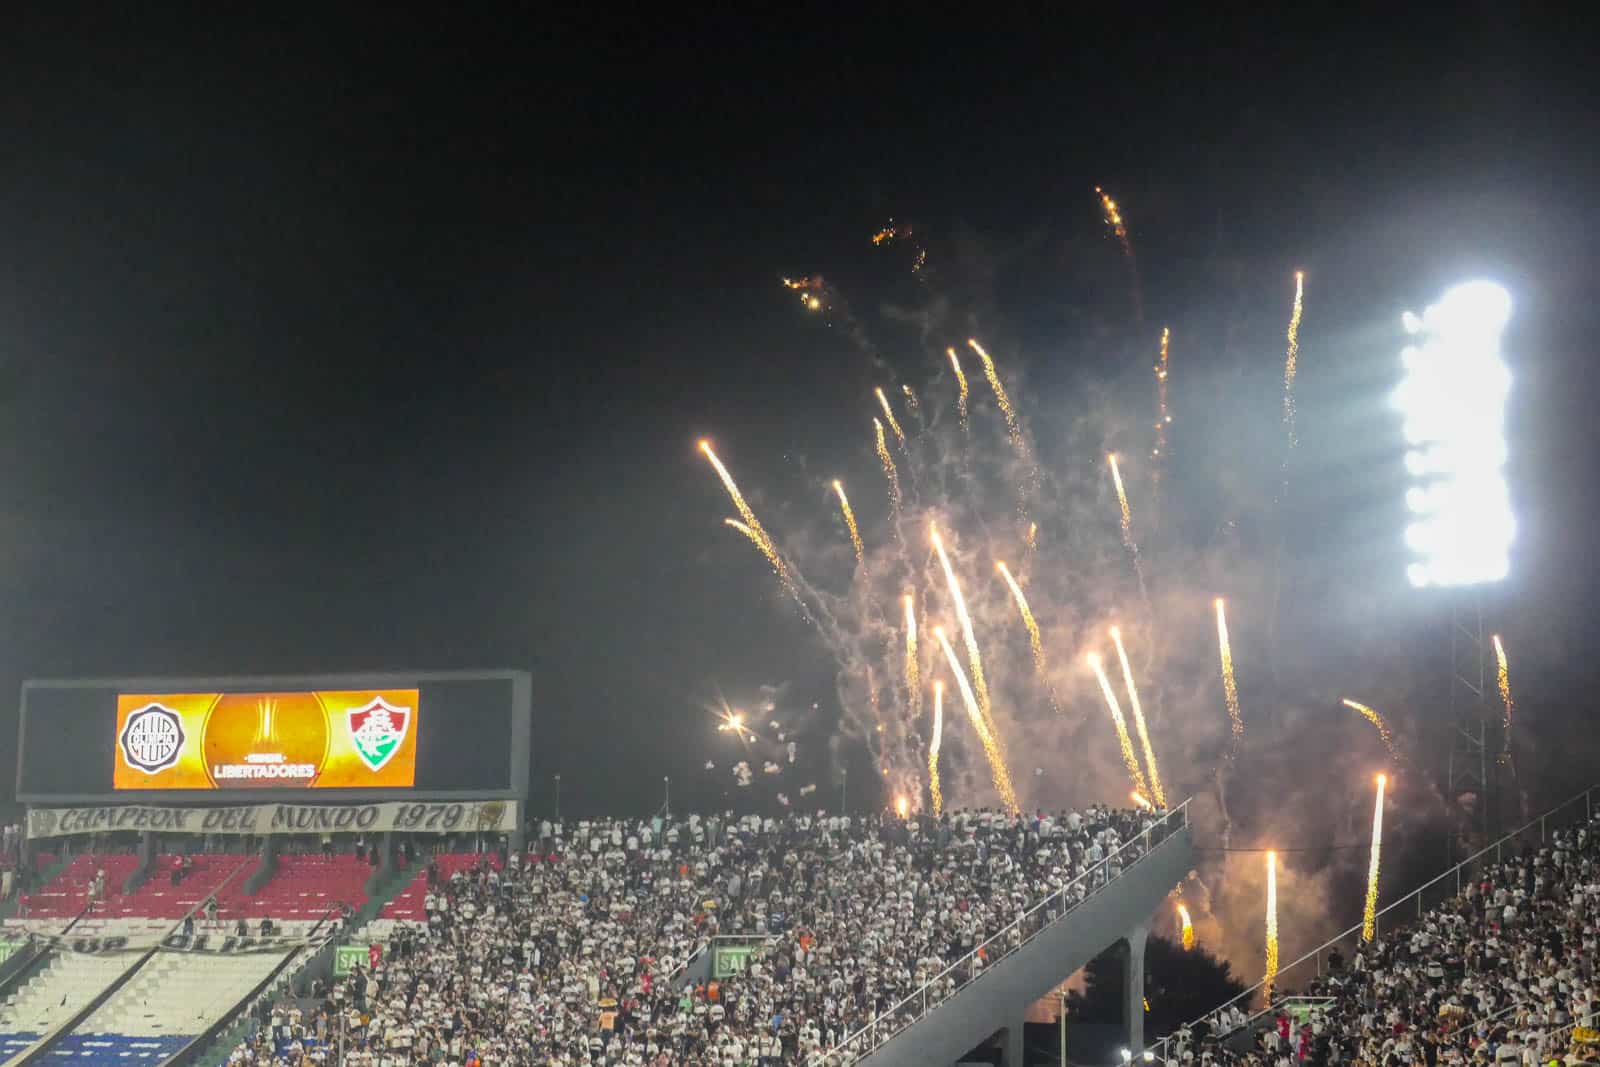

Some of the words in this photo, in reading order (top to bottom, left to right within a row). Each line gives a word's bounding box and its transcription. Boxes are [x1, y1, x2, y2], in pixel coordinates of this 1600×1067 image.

[214, 764, 316, 778] LIBERTADORES
[59, 806, 192, 831] CAMPEON
[201, 806, 257, 830] DEL
[271, 804, 380, 829] MUNDO
[391, 803, 465, 829] 1979
